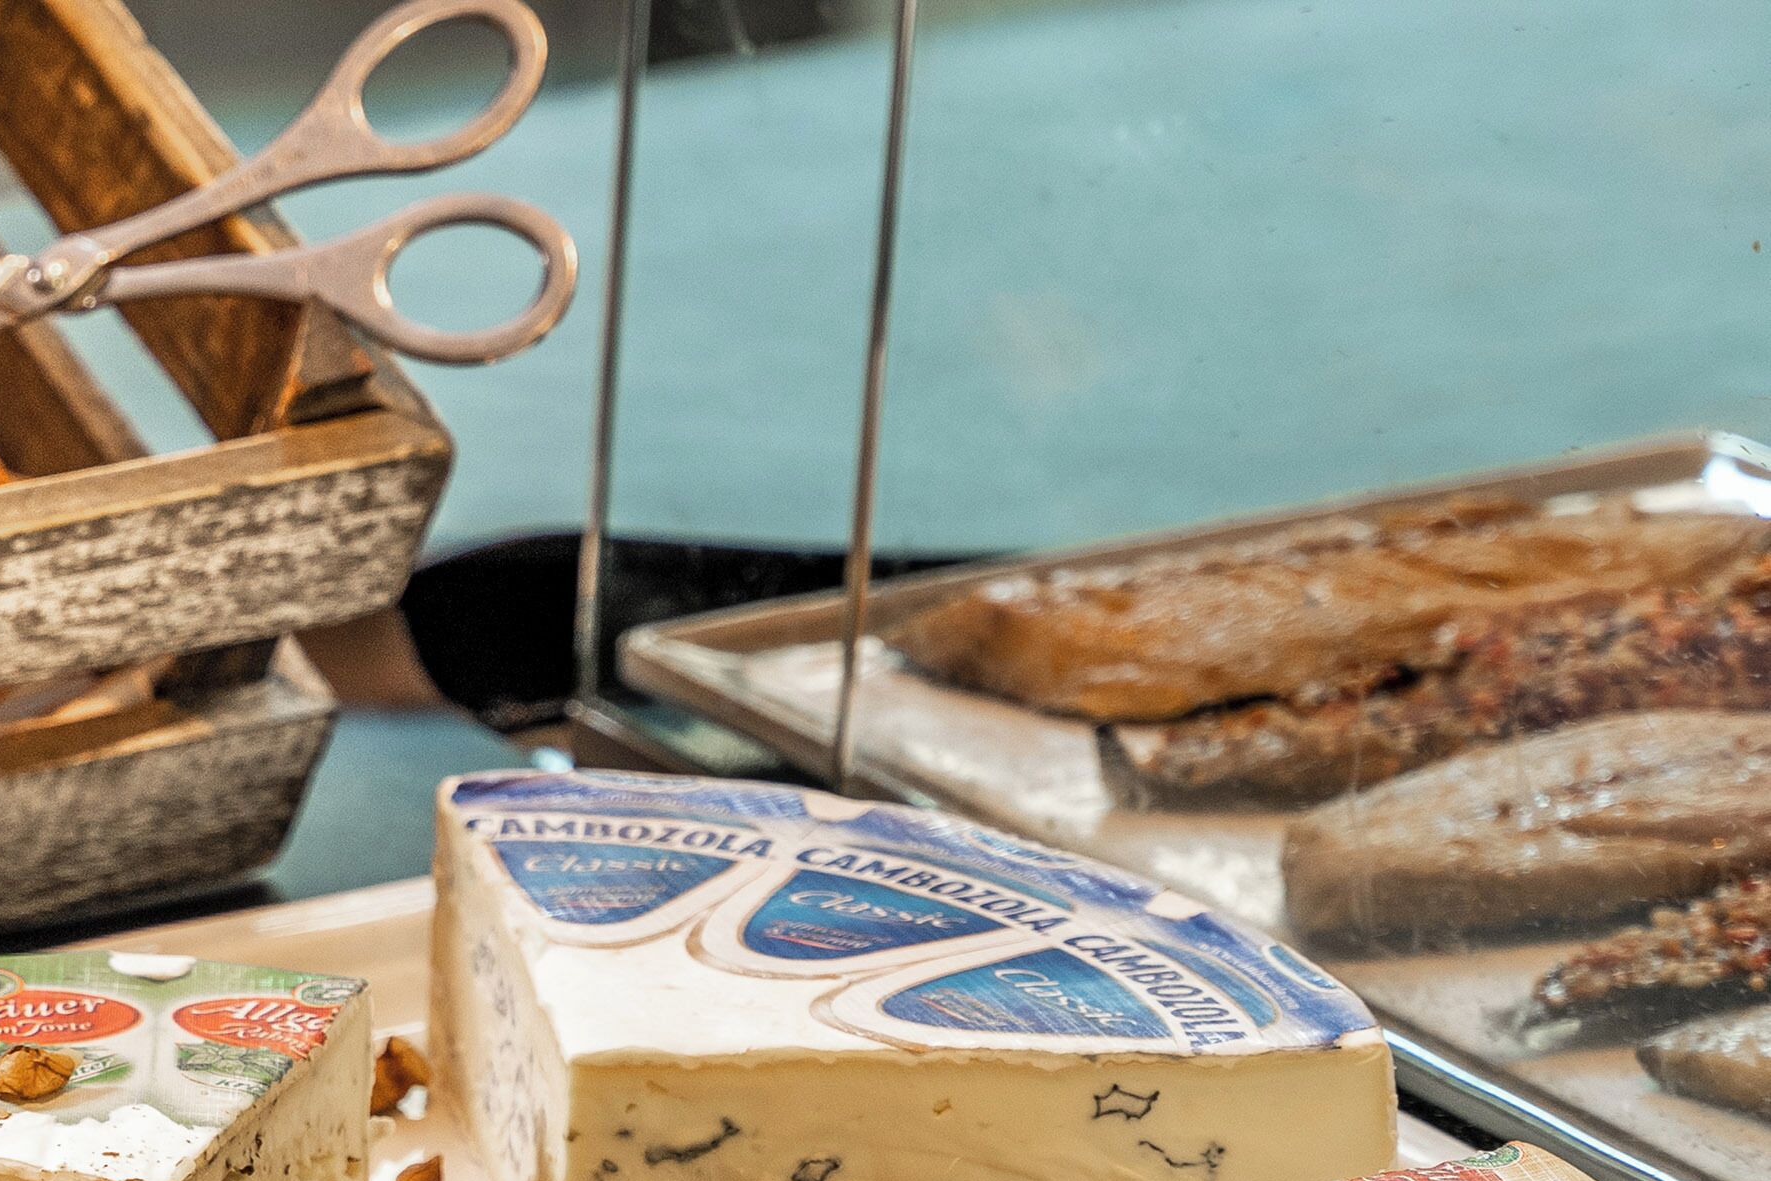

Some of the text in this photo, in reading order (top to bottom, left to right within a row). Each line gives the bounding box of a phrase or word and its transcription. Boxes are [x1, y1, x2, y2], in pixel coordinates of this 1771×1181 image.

[789, 889, 968, 930] Classic
[795, 848, 1070, 934] CAMBOZOLA
[993, 967, 1136, 1026] Classic
[1064, 935, 1249, 1052] CAMBOZOLA
[14, 1019, 93, 1038] Torte
